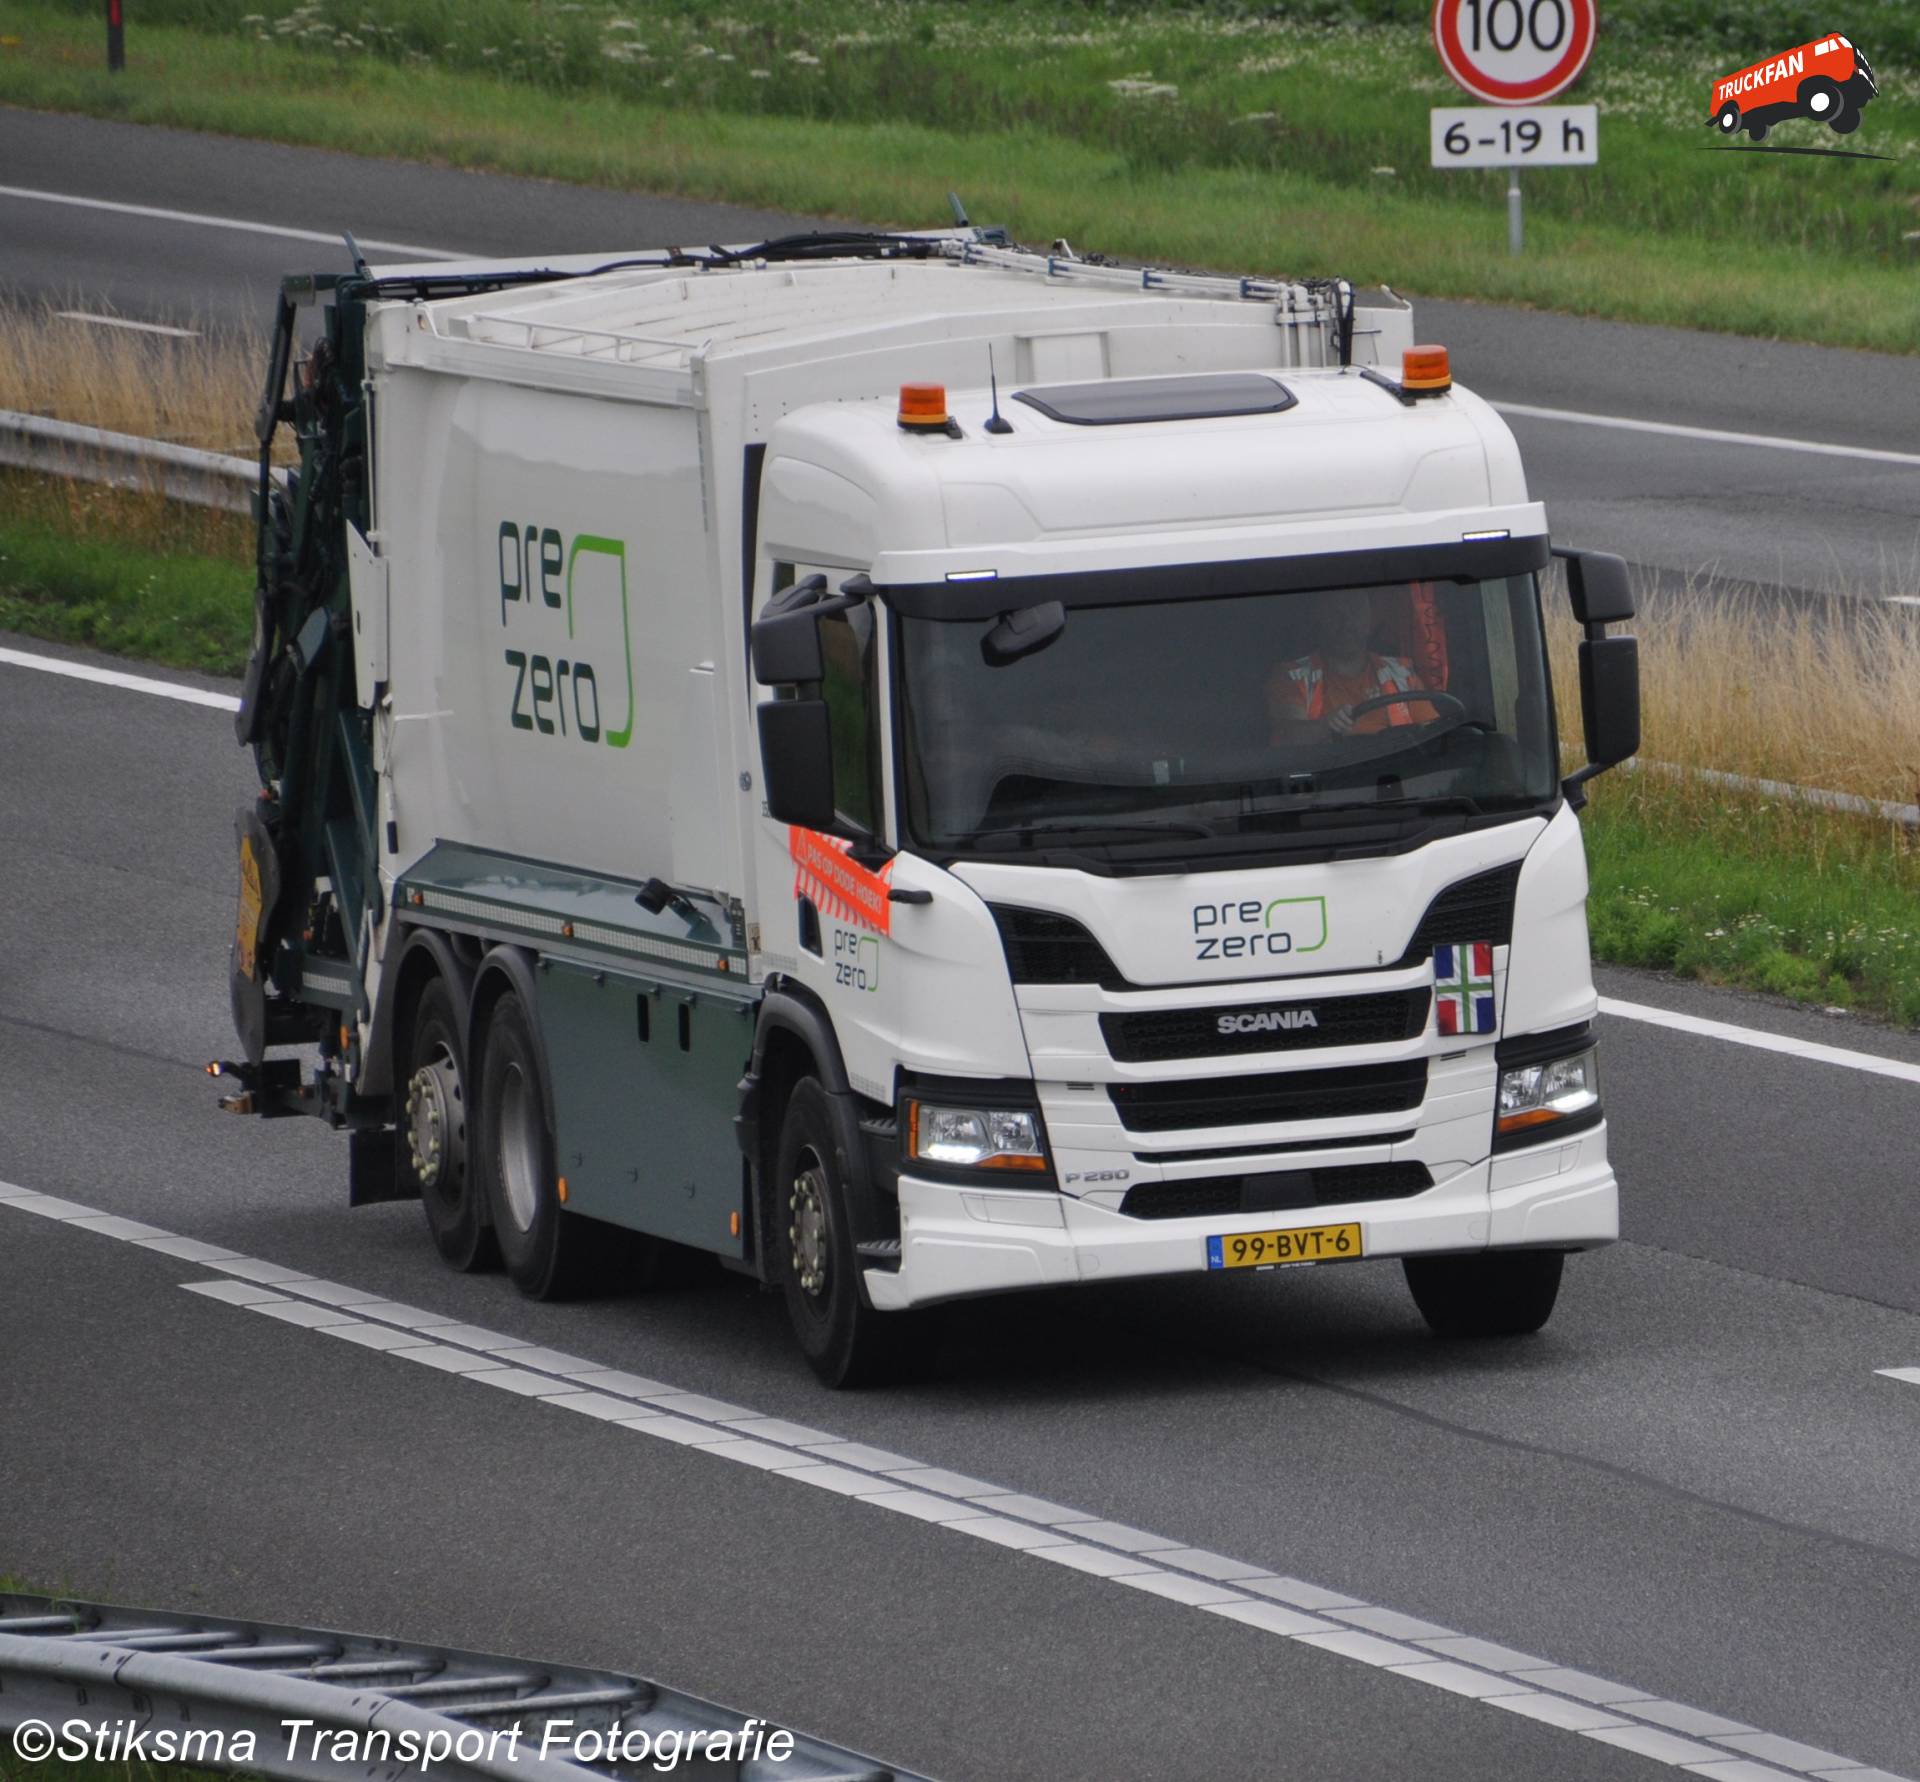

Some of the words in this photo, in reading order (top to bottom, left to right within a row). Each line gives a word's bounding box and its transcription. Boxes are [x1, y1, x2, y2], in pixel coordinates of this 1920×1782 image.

[1467, 0, 1566, 52] 100
[1444, 120, 1542, 155] 6-19
[1562, 118, 1585, 153] h
[499, 520, 563, 628] pre
[505, 649, 600, 743] zero
[1193, 901, 1262, 934] pre
[834, 929, 857, 956] pre
[1196, 932, 1292, 960] zero
[835, 962, 866, 990] zero
[1217, 1009, 1318, 1034] SCANIA
[1065, 1172, 1080, 1184] P
[1084, 1169, 1130, 1182] 280
[1232, 1229, 1350, 1262] 99-BVT-6
